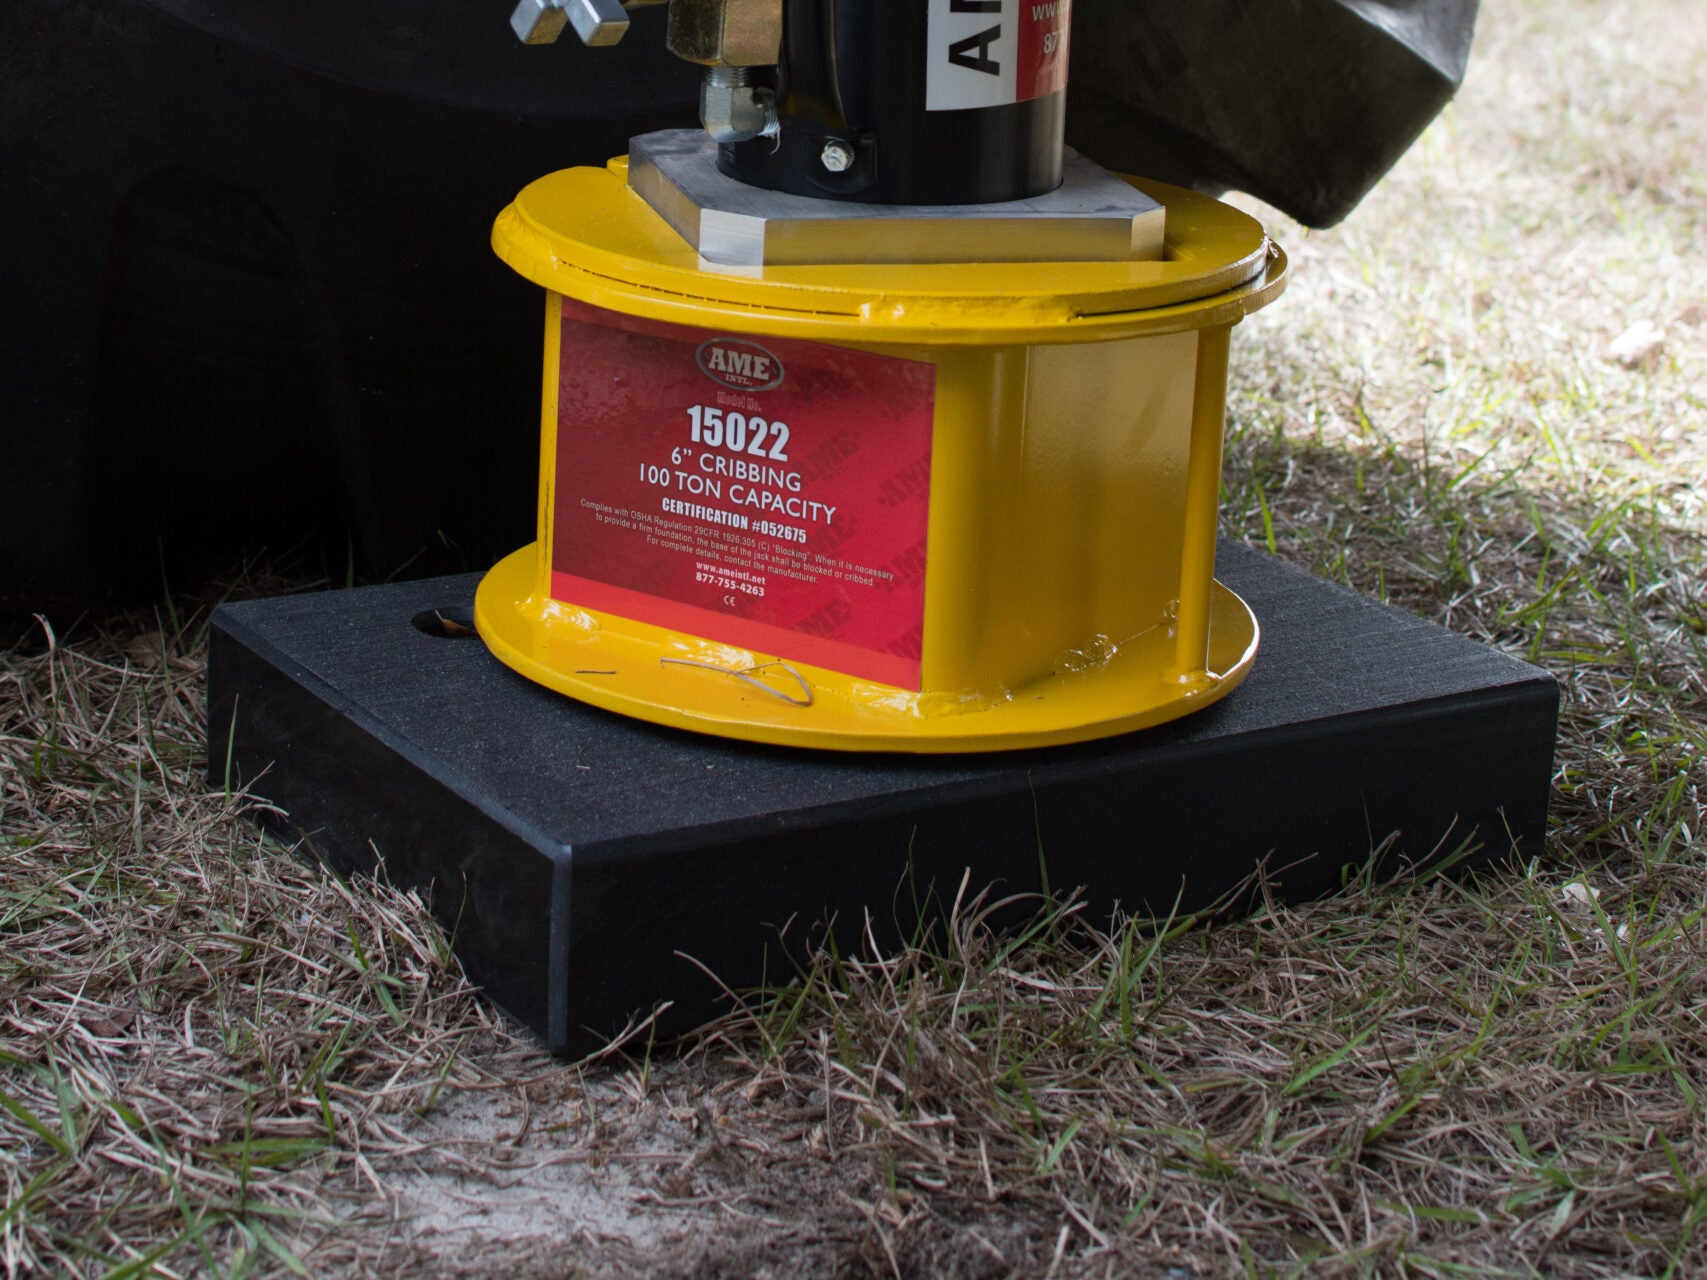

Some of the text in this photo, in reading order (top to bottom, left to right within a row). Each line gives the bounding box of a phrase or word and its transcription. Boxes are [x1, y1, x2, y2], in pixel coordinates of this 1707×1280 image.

[708, 347, 771, 381] AME
[686, 404, 790, 463] 15022
[640, 463, 837, 525] 100 TON CAPACITY
[699, 452, 801, 492] CRIBBING
[580, 498, 613, 514] Complies
[615, 506, 629, 517] with
[631, 510, 652, 523] OSHA
[654, 516, 692, 533] Regulation
[694, 525, 720, 539] 29CFR
[723, 532, 756, 548] 1926.305
[758, 541, 770, 553] (C)
[815, 554, 836, 568] When
[839, 560, 844, 569] it
[846, 561, 853, 571] is
[855, 565, 894, 582] necessary
[662, 497, 749, 531] CERTIFICATION
[752, 520, 807, 544] #052675
[595, 512, 603, 521] to
[604, 514, 631, 528] provide
[632, 522, 637, 530] a
[639, 522, 653, 534] firm
[697, 537, 709, 547] the
[710, 540, 728, 553] base
[731, 544, 738, 554] of
[740, 546, 752, 558] the
[754, 549, 769, 563] jack
[771, 554, 789, 566] shall
[791, 558, 801, 569] be
[803, 561, 833, 576] blocked
[835, 569, 843, 579] or
[845, 571, 876, 587] cribbed.
[647, 535, 819, 585] For complete details, contact the manufacturer.
[696, 561, 767, 585] www.ameintl.net
[695, 572, 766, 597] 877-755-4263
